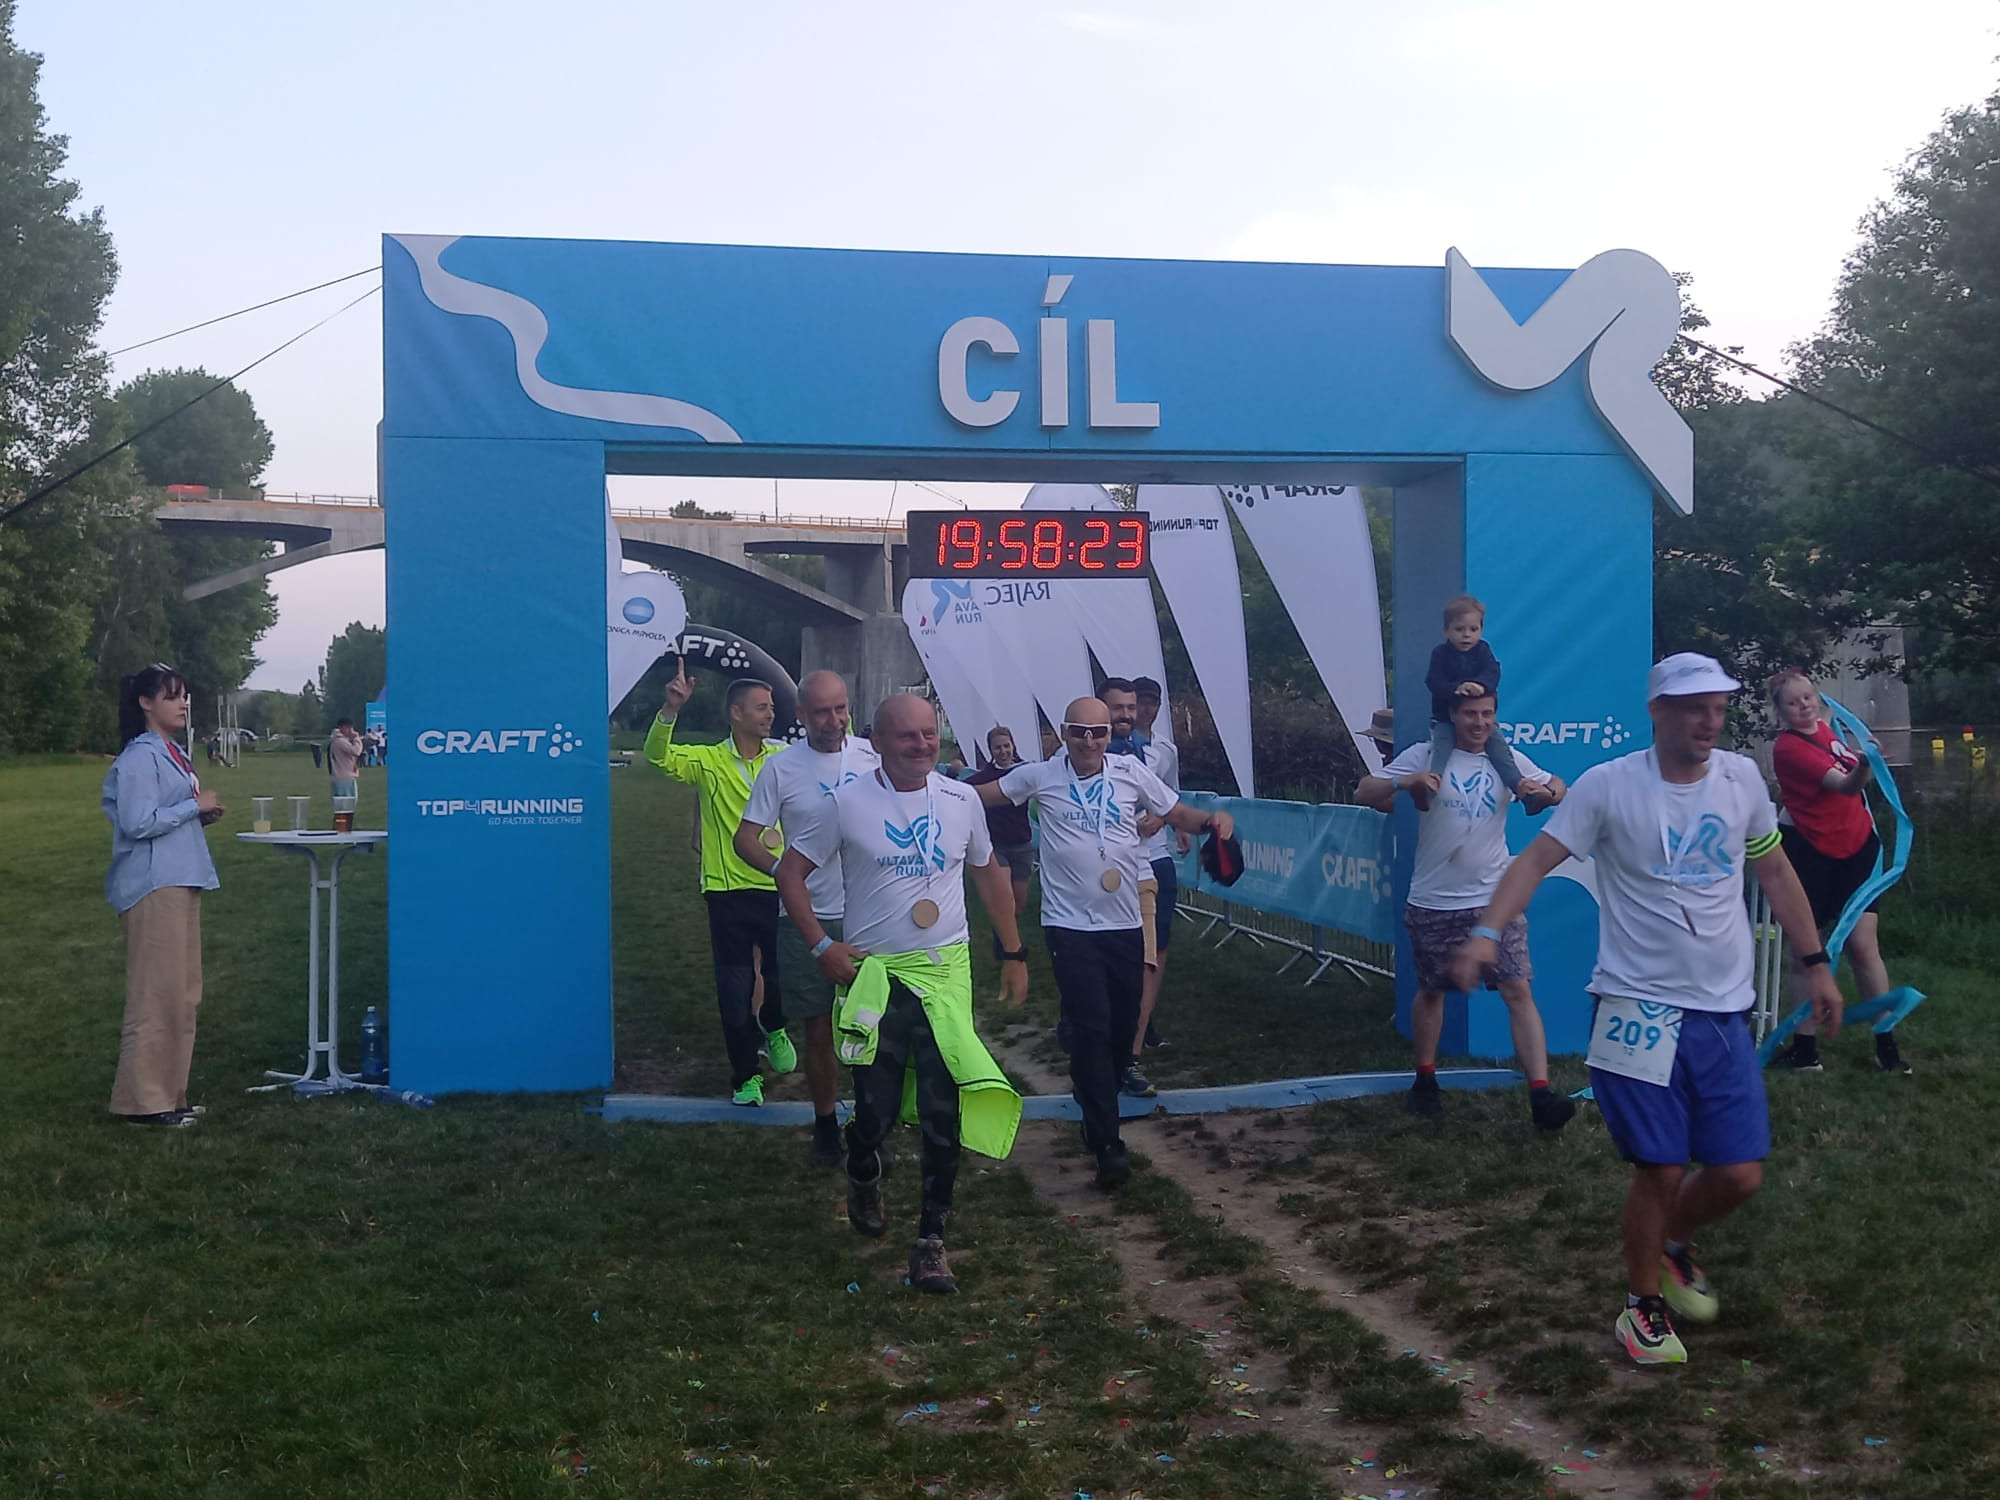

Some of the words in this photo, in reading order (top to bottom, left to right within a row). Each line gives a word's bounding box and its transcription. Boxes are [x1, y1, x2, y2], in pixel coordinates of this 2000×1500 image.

[938, 274, 1161, 428] CÍL
[937, 519, 1144, 570] 19:58:23
[606, 625, 630, 635] ONICA
[664, 635, 726, 658] AFT
[416, 730, 547, 754] CRAFT
[416, 798, 584, 816] TOP4RUNNING
[488, 817, 500, 825] GO
[502, 816, 535, 825] FASTER
[538, 815, 583, 825] TOGETHER
[876, 855, 923, 867] VLTAVA
[895, 865, 923, 877] RUN
[1240, 840, 1296, 879] UNNING
[1605, 1015, 1662, 1051] 209
